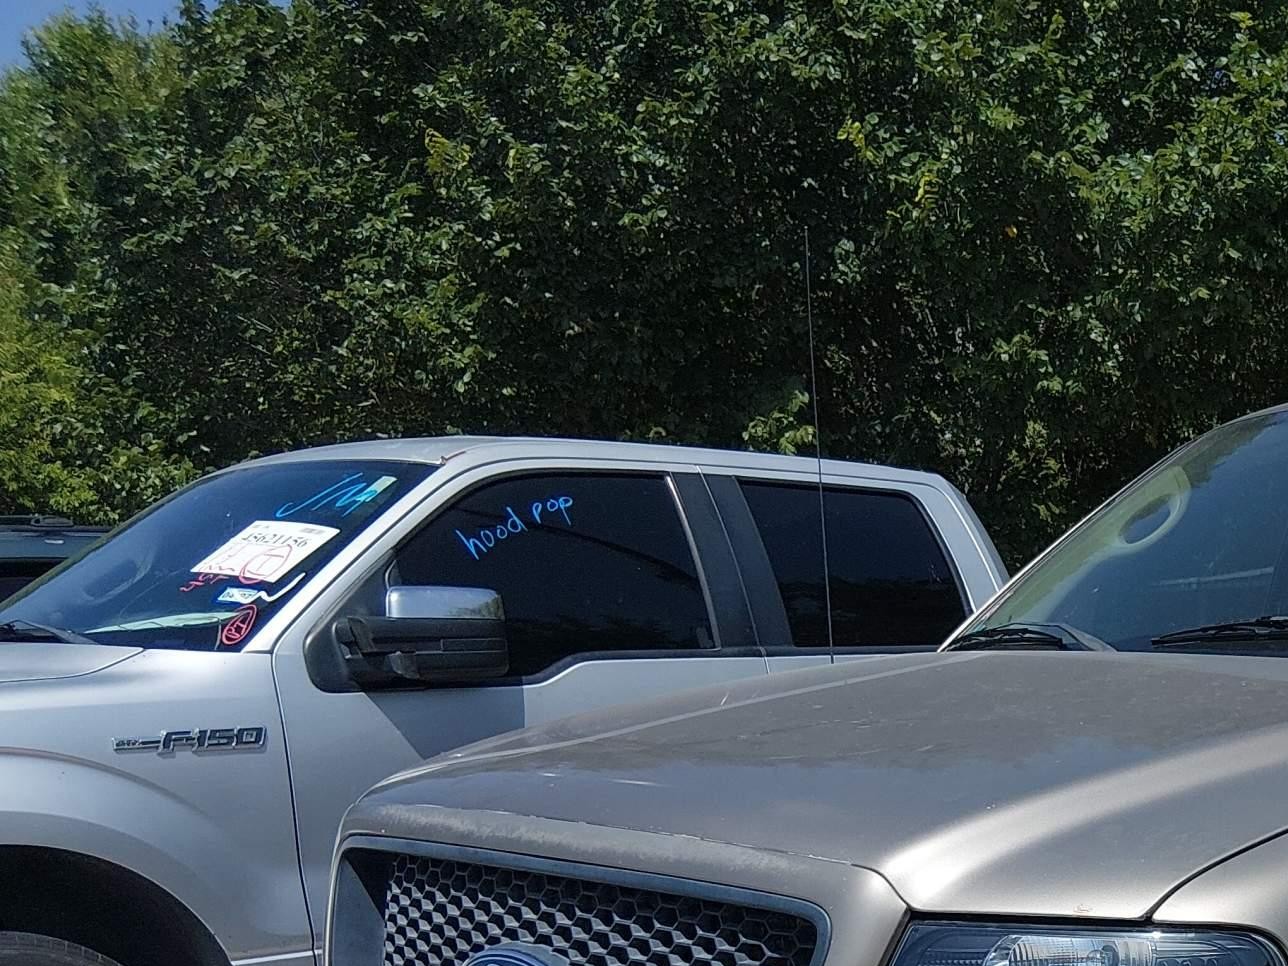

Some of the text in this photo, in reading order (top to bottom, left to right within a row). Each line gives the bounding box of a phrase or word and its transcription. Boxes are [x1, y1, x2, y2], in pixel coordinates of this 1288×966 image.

[455, 496, 573, 560] hood pop
[158, 726, 267, 752] F-150
